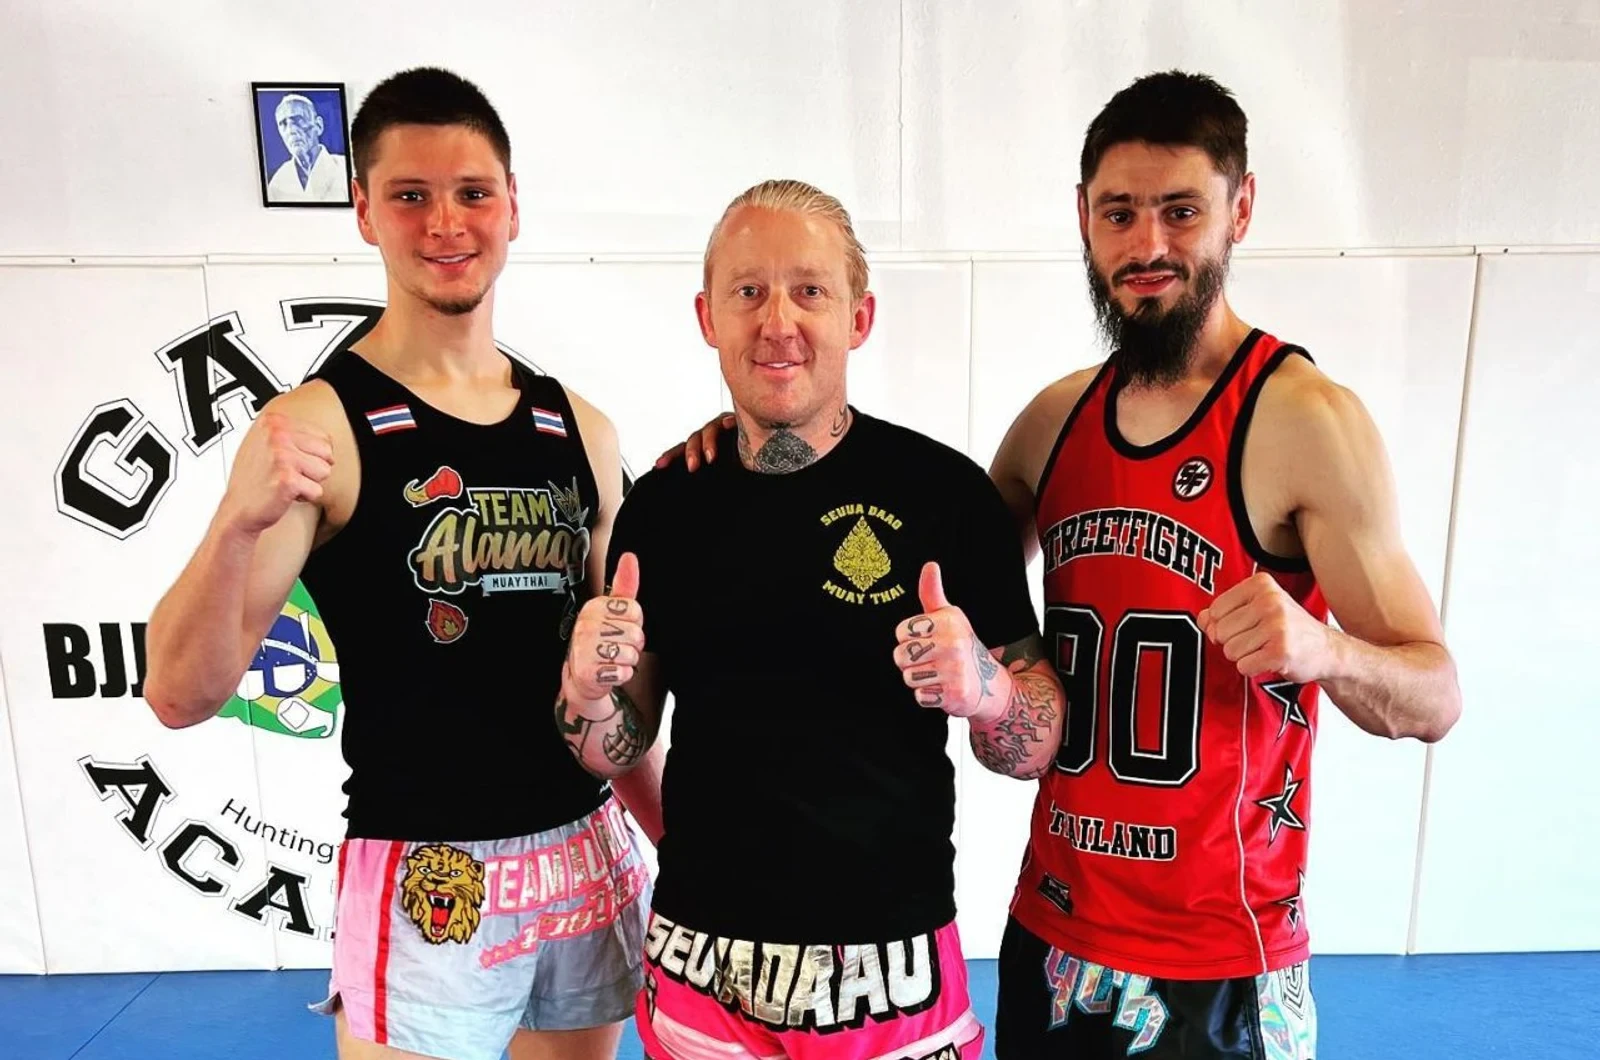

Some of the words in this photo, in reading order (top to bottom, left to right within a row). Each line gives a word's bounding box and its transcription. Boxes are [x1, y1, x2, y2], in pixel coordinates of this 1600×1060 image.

[54, 297, 387, 540] GAZ
[473, 491, 552, 525] TEAM
[1043, 507, 1223, 596] TREETFIGHT
[822, 580, 865, 604] MUAY
[869, 584, 905, 605] THAI
[77, 754, 341, 942] ACA
[220, 798, 342, 865] Hunting
[1049, 799, 1177, 862] TAILAND
